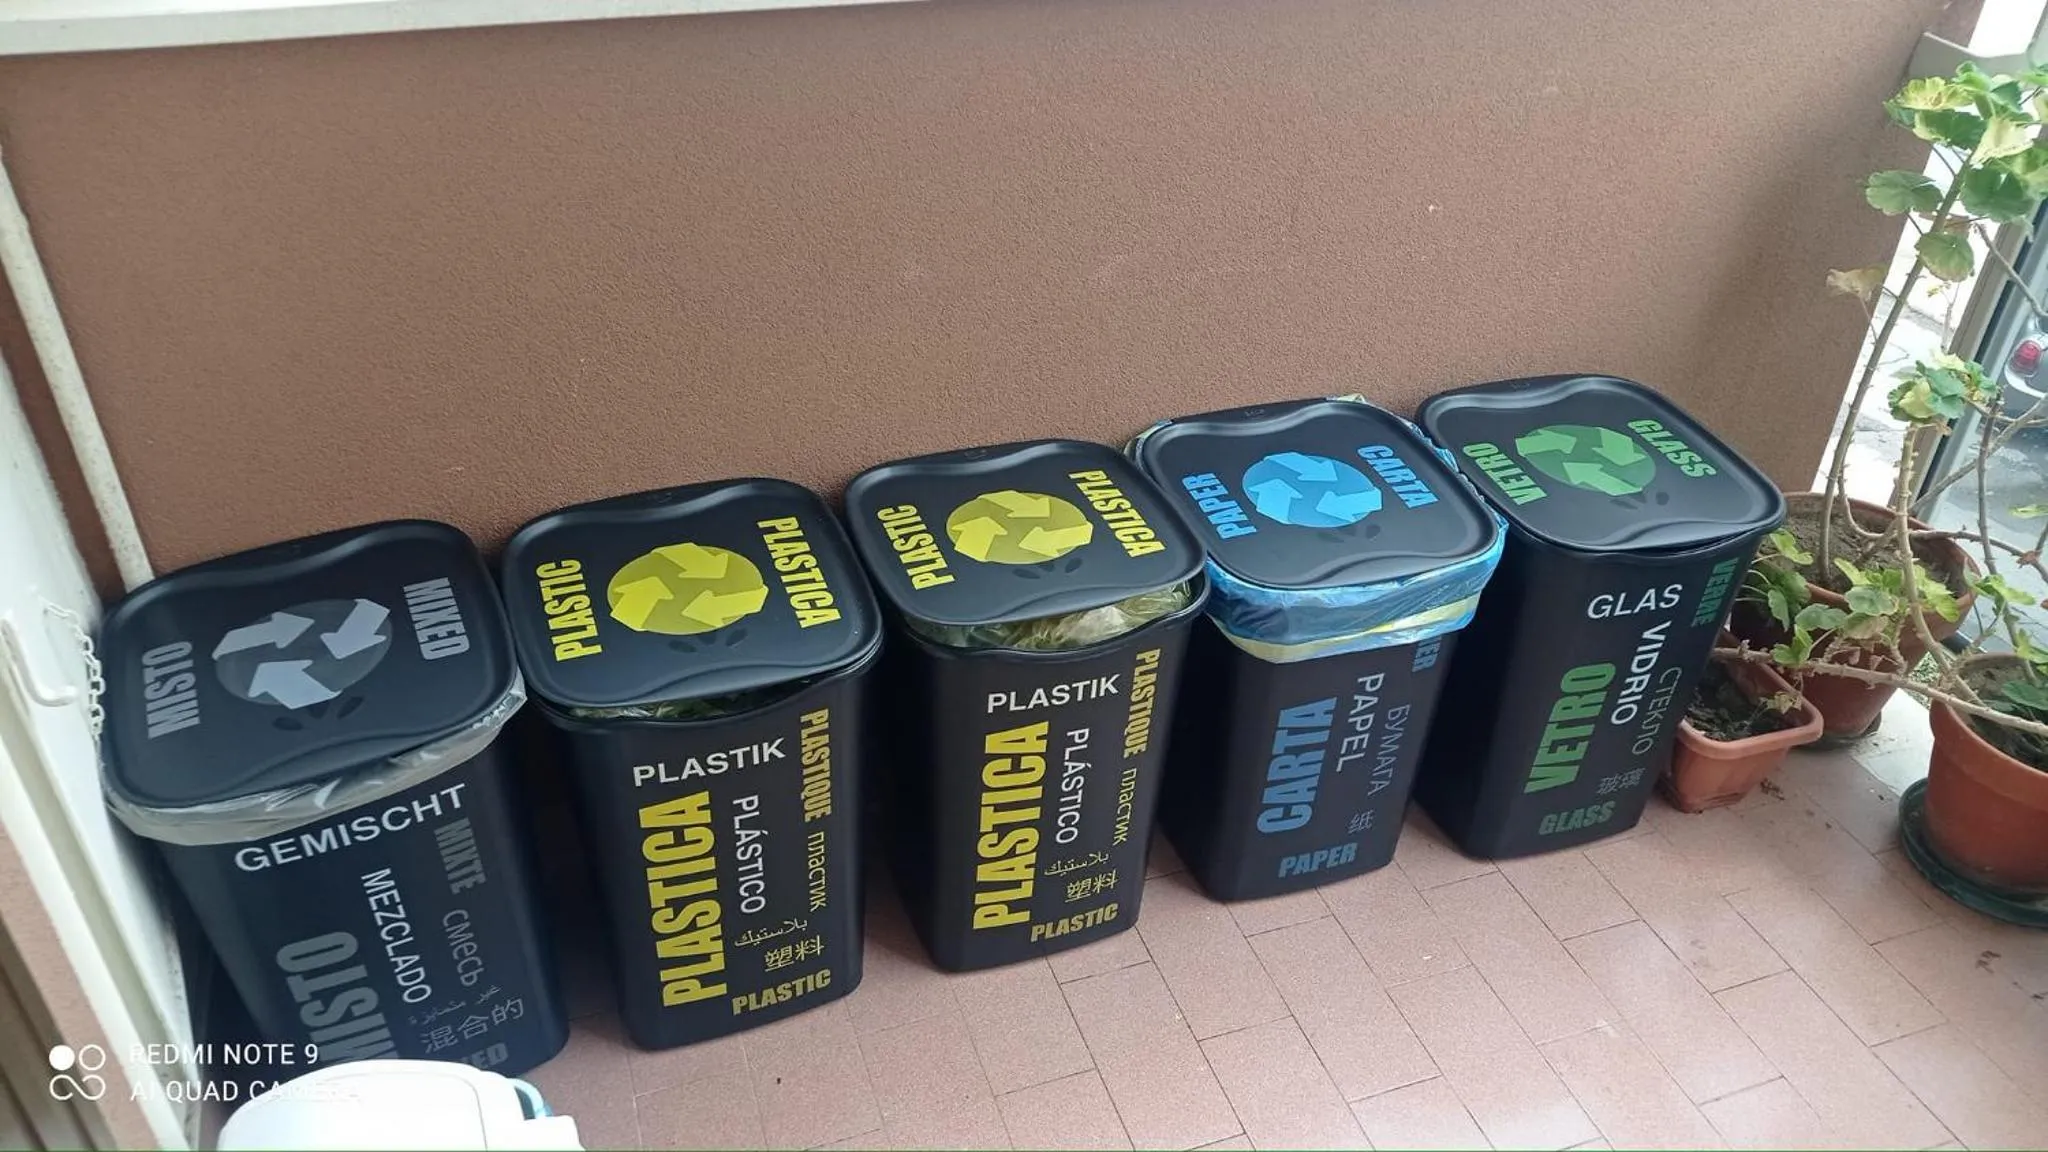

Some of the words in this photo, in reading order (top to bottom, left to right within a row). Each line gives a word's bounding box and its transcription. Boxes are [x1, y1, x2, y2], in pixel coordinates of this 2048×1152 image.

[1357, 444, 1439, 509] CARTA
[1463, 443, 1547, 505] VETRO
[1627, 419, 1717, 478] GLASS
[1068, 470, 1166, 558] PLASTICA
[1182, 472, 1257, 540] PAPER
[757, 516, 842, 629] PLASTICA
[877, 504, 956, 591] PLASTIC
[403, 577, 470, 660] MIXED
[535, 559, 603, 662] PLASTIC
[1587, 583, 1683, 619] GLAS
[1691, 557, 1740, 628] VERRE
[142, 641, 200, 739] MISTO
[987, 673, 1122, 713] PLASTIK
[1123, 647, 1161, 760] PLASTIQUE
[1610, 620, 1672, 726] VIDRIO
[633, 737, 786, 787] PLASTIK
[1336, 672, 1386, 773] PAPEL
[1524, 662, 1616, 793] VETRO
[800, 707, 832, 824] PLASTIQUE
[1055, 727, 1092, 845] PLÁSTICO
[1256, 696, 1338, 834] CARTA
[234, 783, 465, 872] GEMISCHT
[433, 816, 488, 895] MIXTE
[732, 794, 768, 915] PLÁSTICO
[973, 720, 1049, 930] PLASTICA
[1539, 799, 1616, 836] GLASS
[638, 790, 728, 1007] PLASTICA
[1044, 851, 1110, 877] بلاستيك
[1064, 868, 1120, 903] 塑料
[1278, 842, 1359, 879] PAPER
[361, 867, 433, 1004] MEZCLADO
[735, 917, 808, 947] بلاستيك
[764, 934, 825, 973] 塑料
[1030, 902, 1119, 944] PLASTIC
[420, 998, 524, 1054] 混合的
[732, 968, 831, 1016] PLASTIC
